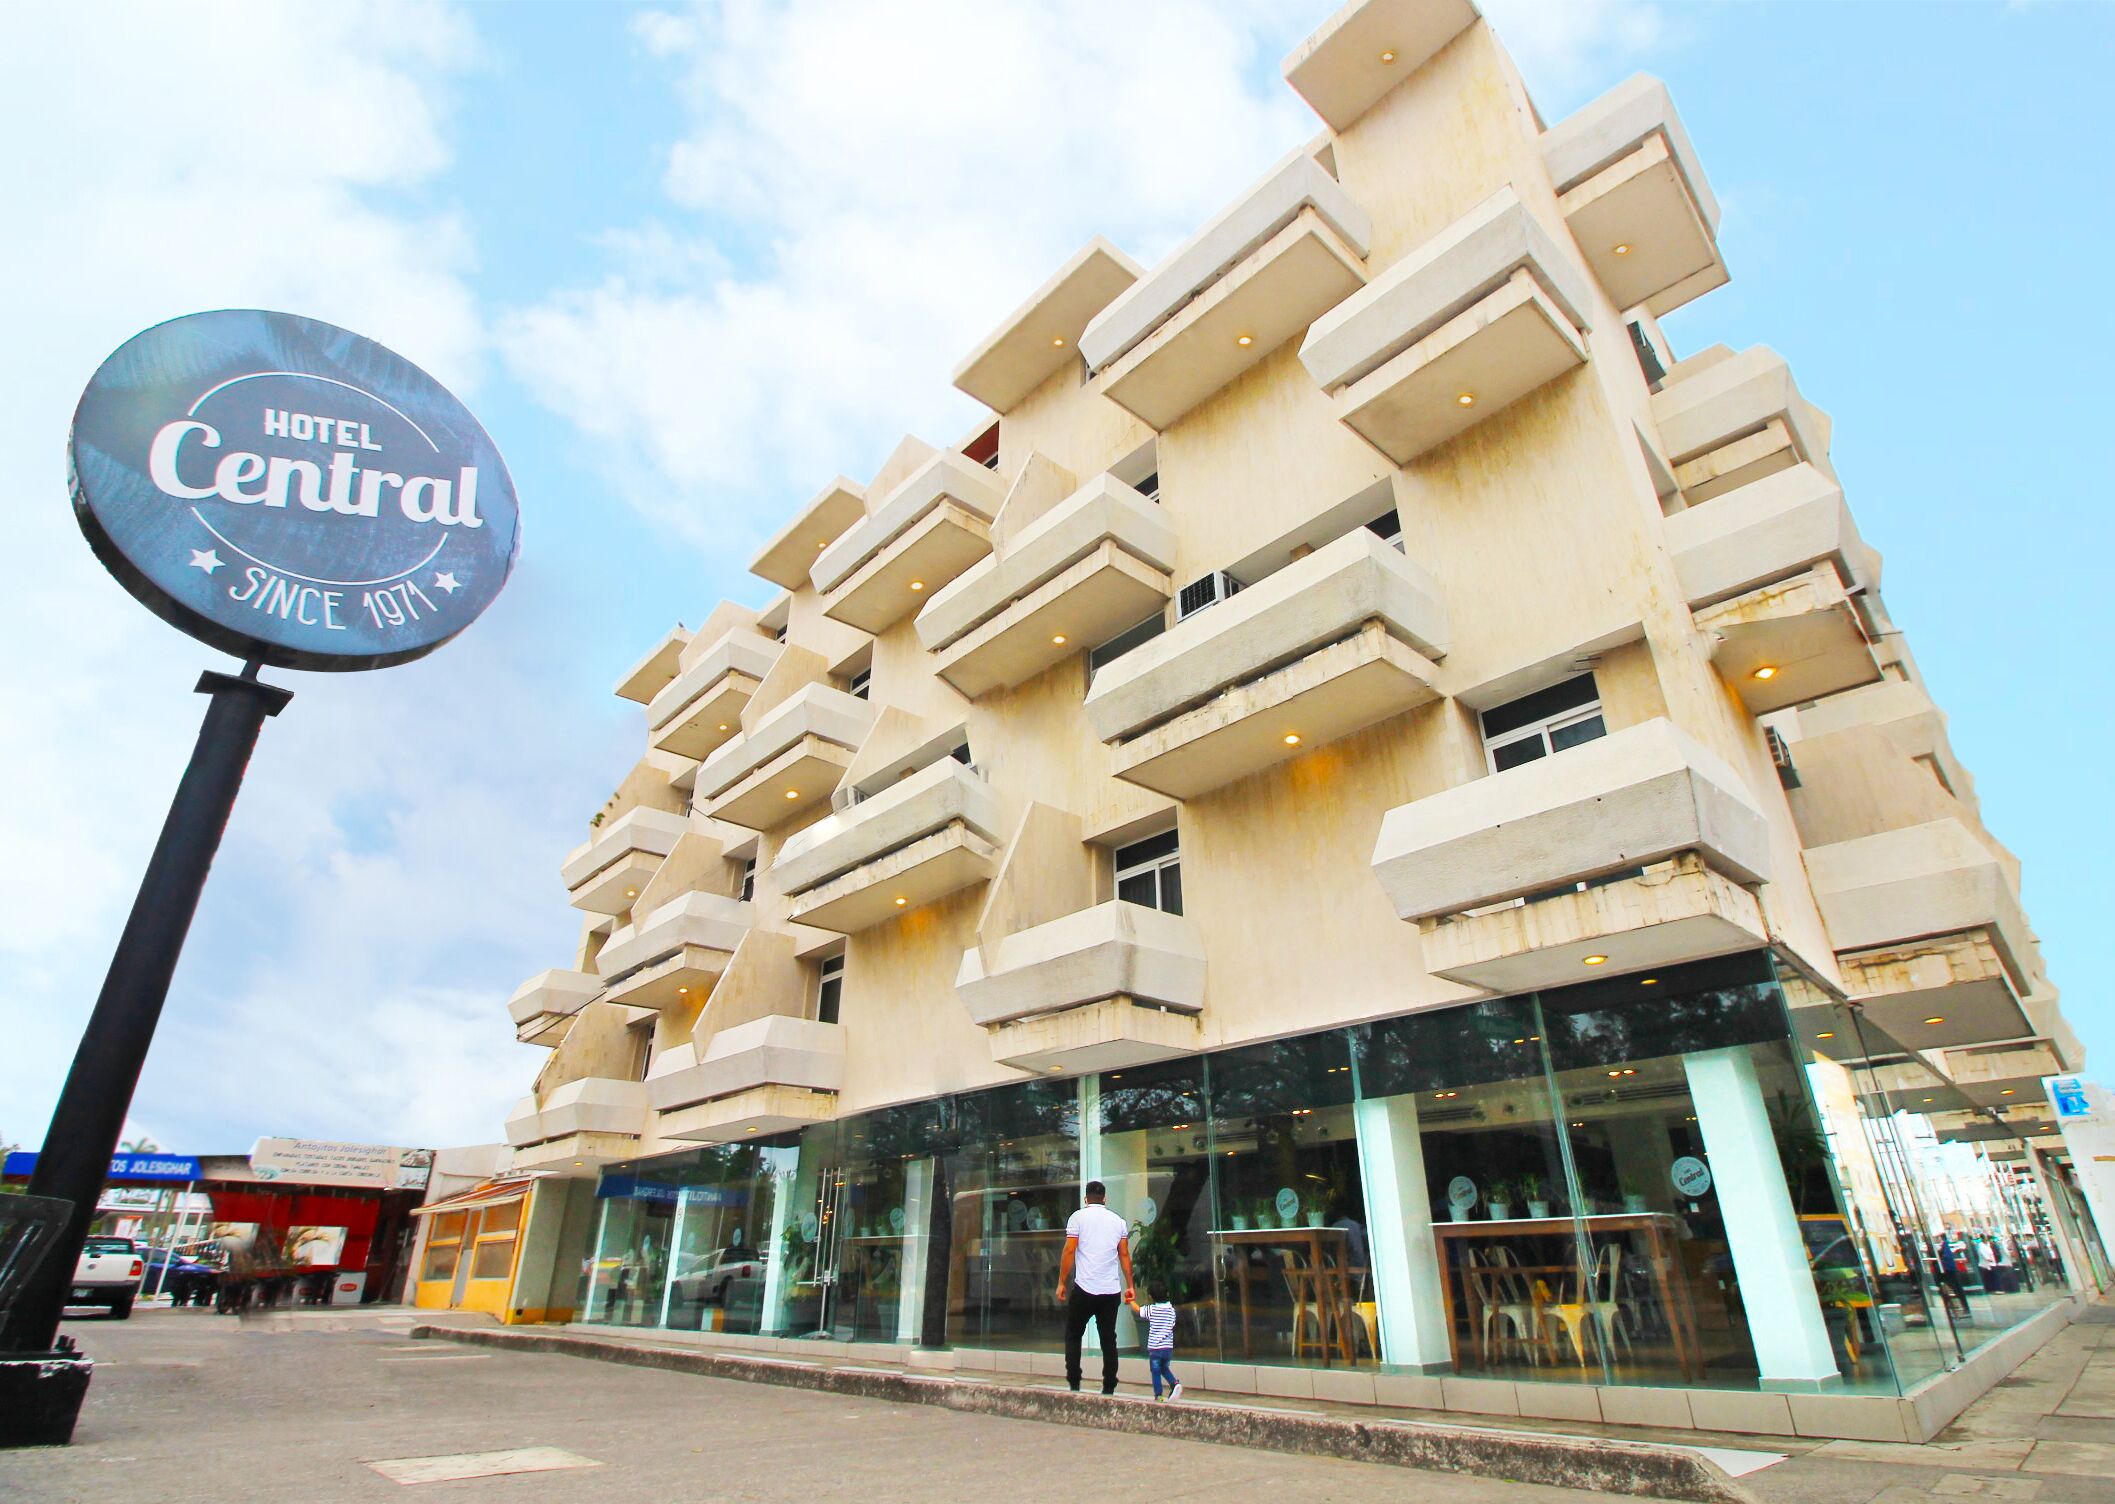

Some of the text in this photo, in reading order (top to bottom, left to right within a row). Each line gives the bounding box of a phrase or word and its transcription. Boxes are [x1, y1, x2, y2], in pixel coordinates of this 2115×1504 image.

[264, 408, 382, 451] HOTEL
[149, 420, 483, 528] Central
[229, 566, 438, 630] SINCE 1971
